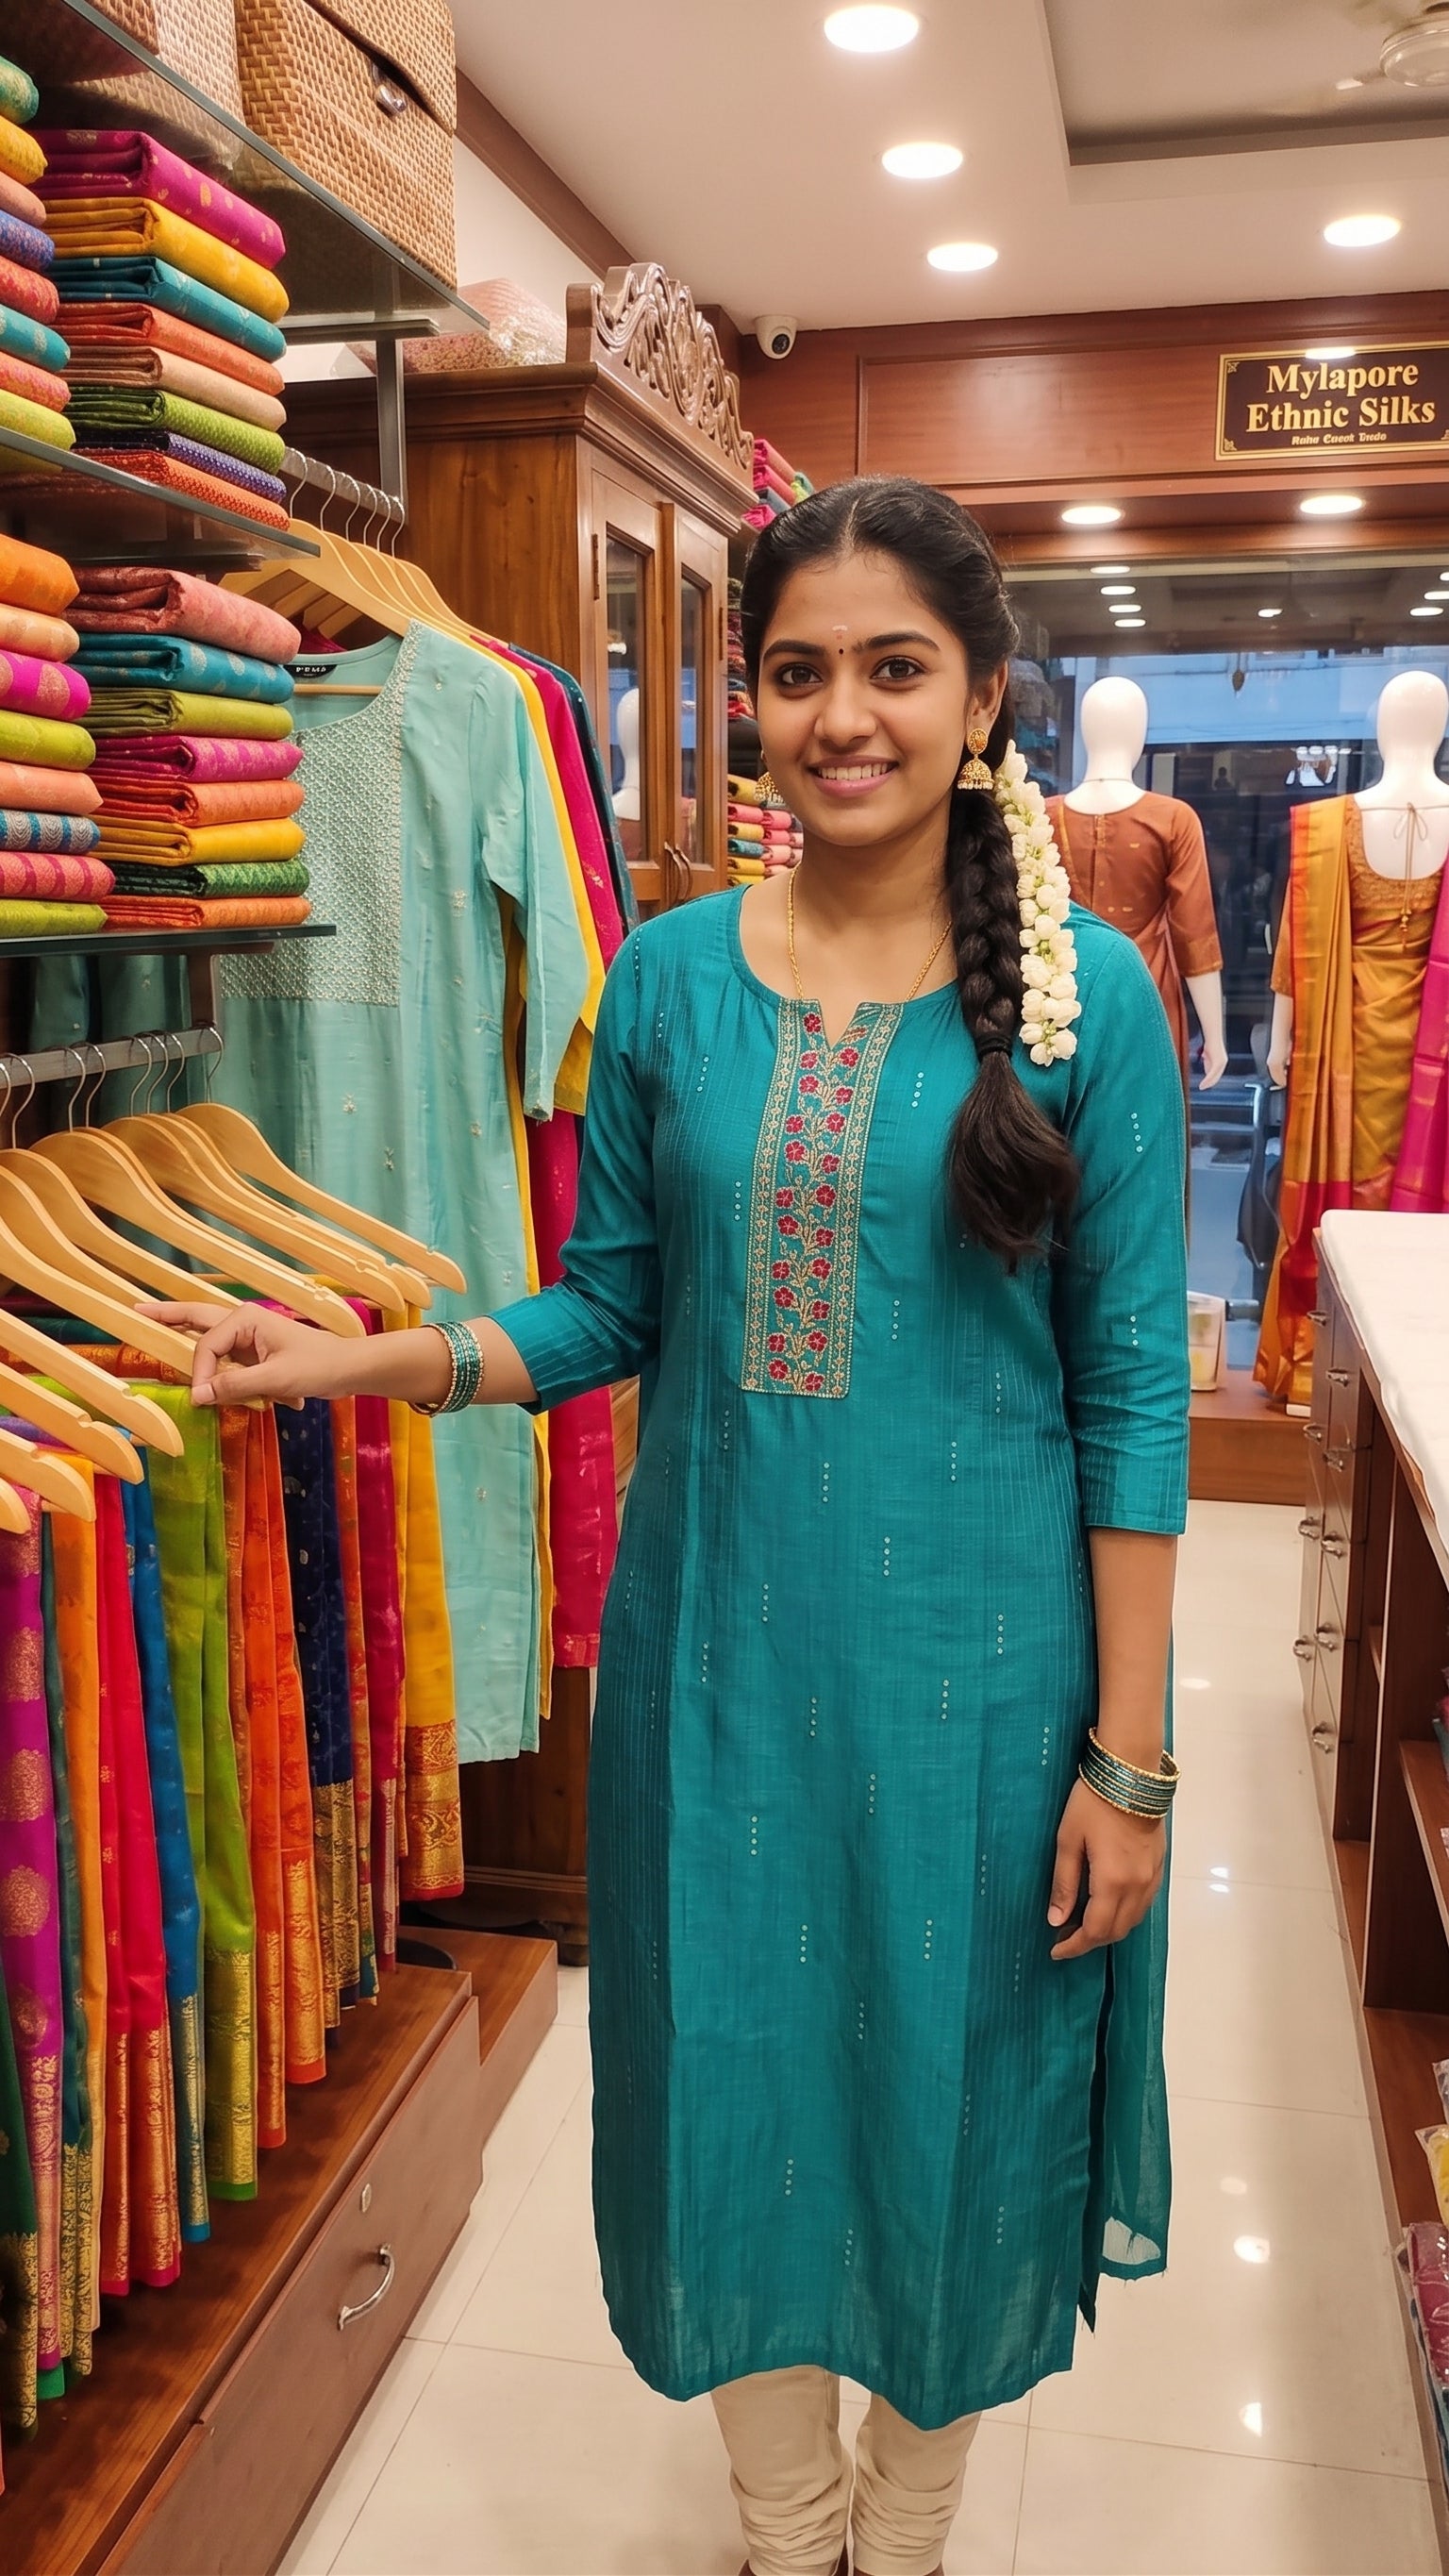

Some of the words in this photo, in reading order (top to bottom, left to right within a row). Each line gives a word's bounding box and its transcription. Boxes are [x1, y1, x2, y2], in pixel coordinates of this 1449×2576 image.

[1266, 362, 1419, 400] Mylapore
[1246, 400, 1349, 432] Ethnic
[1359, 396, 1436, 427] Silks
